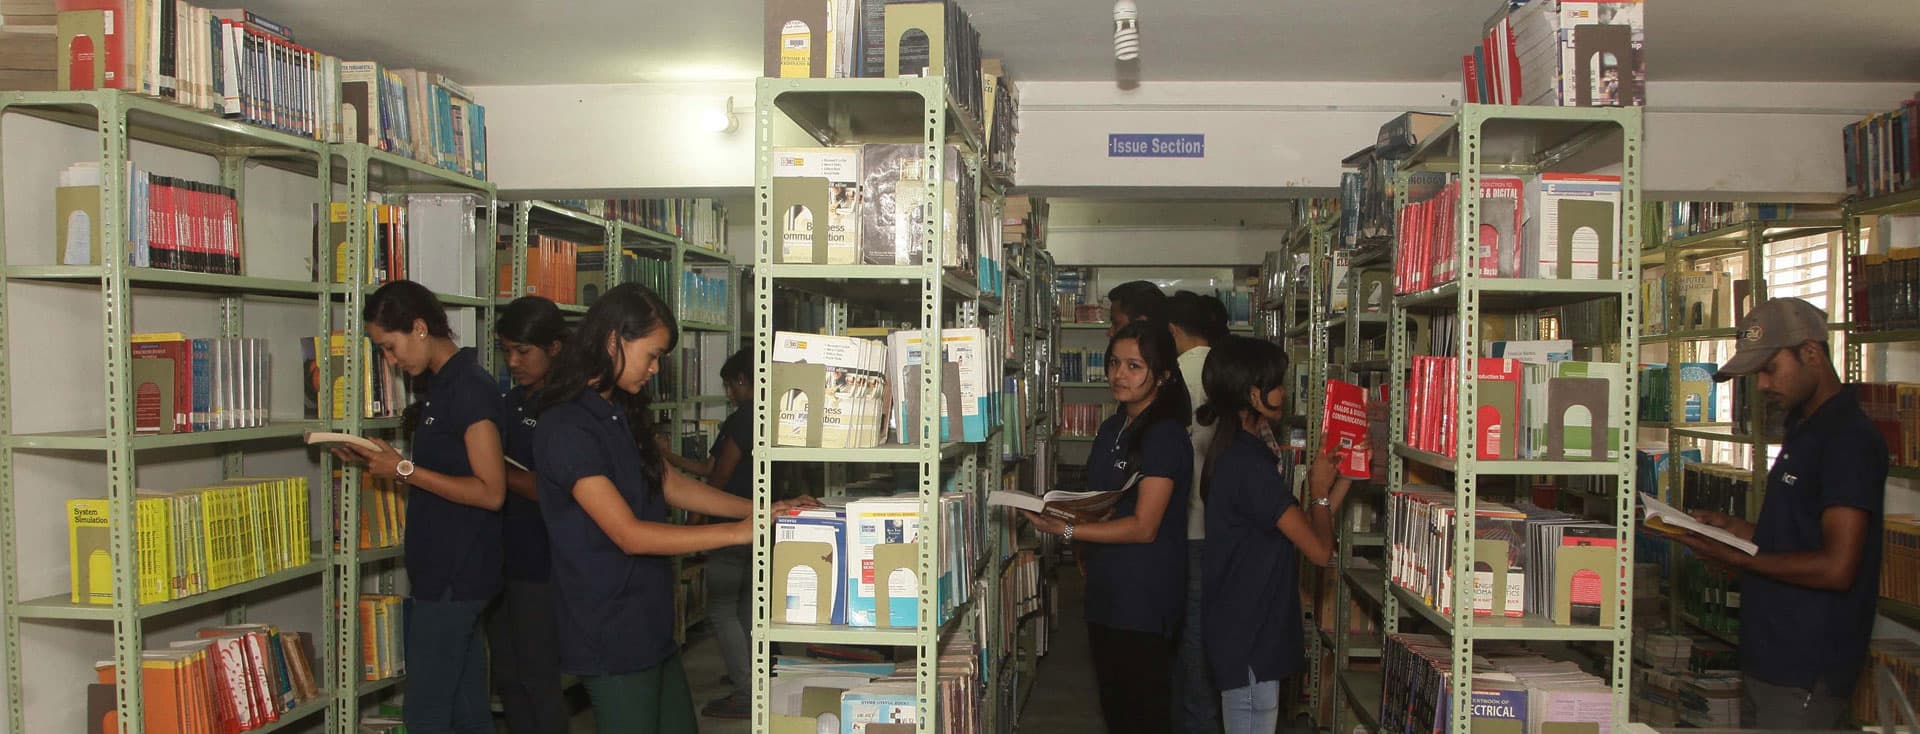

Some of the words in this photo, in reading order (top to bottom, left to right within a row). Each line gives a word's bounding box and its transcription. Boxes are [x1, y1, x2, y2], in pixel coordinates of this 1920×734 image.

[1113, 137, 1148, 153] Issue
[1152, 136, 1201, 153] Section
[1485, 188, 1491, 198] &
[1493, 188, 1518, 199] DIGITAL
[74, 508, 98, 516] System
[75, 516, 108, 524] Simulation
[1470, 704, 1516, 717] ECTRICAL
